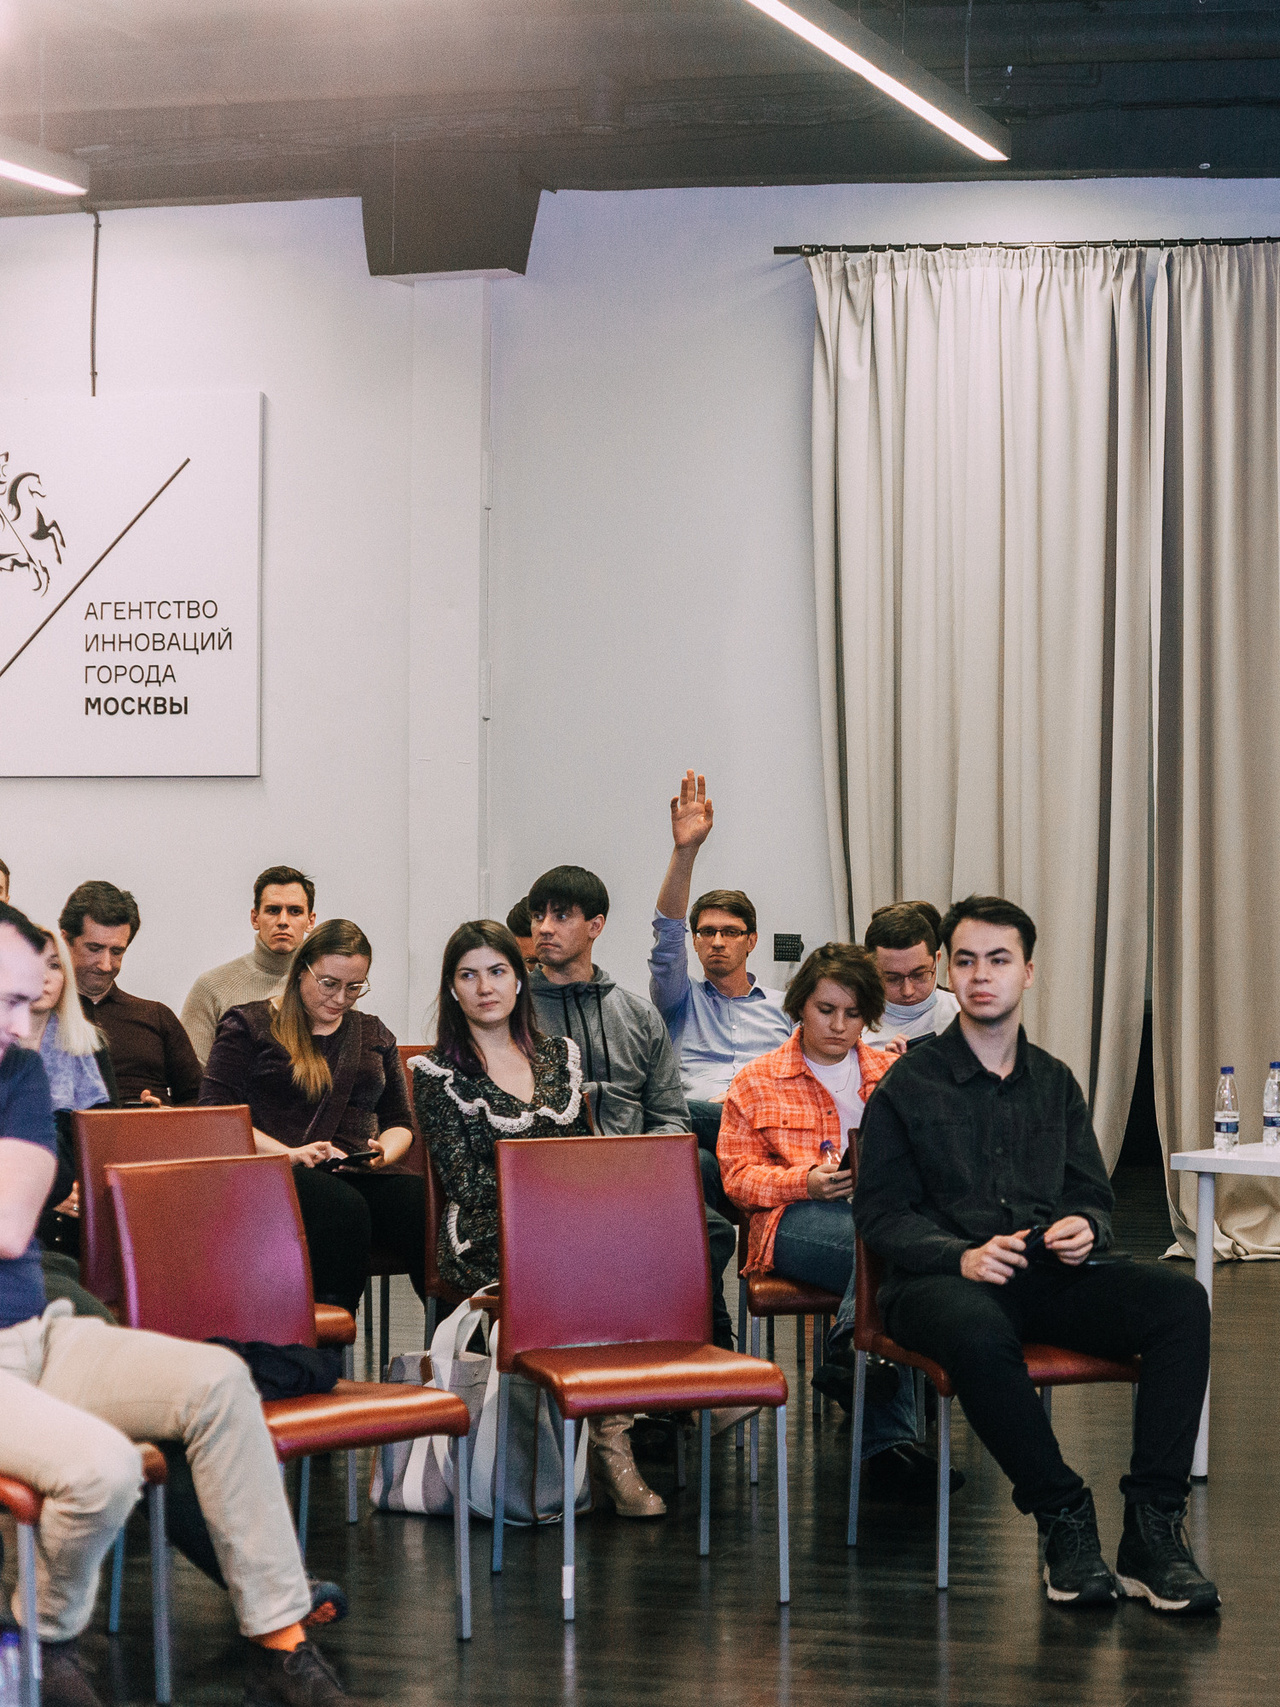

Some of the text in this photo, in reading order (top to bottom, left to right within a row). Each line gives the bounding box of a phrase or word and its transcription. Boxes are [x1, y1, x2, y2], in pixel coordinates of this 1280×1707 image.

[84, 600, 218, 620] АГЕНТСТВО
[85, 627, 232, 655] ИННОВАЦИЙ
[85, 664, 176, 687] ГОРОДА
[85, 696, 188, 715] МОСКВЫ
